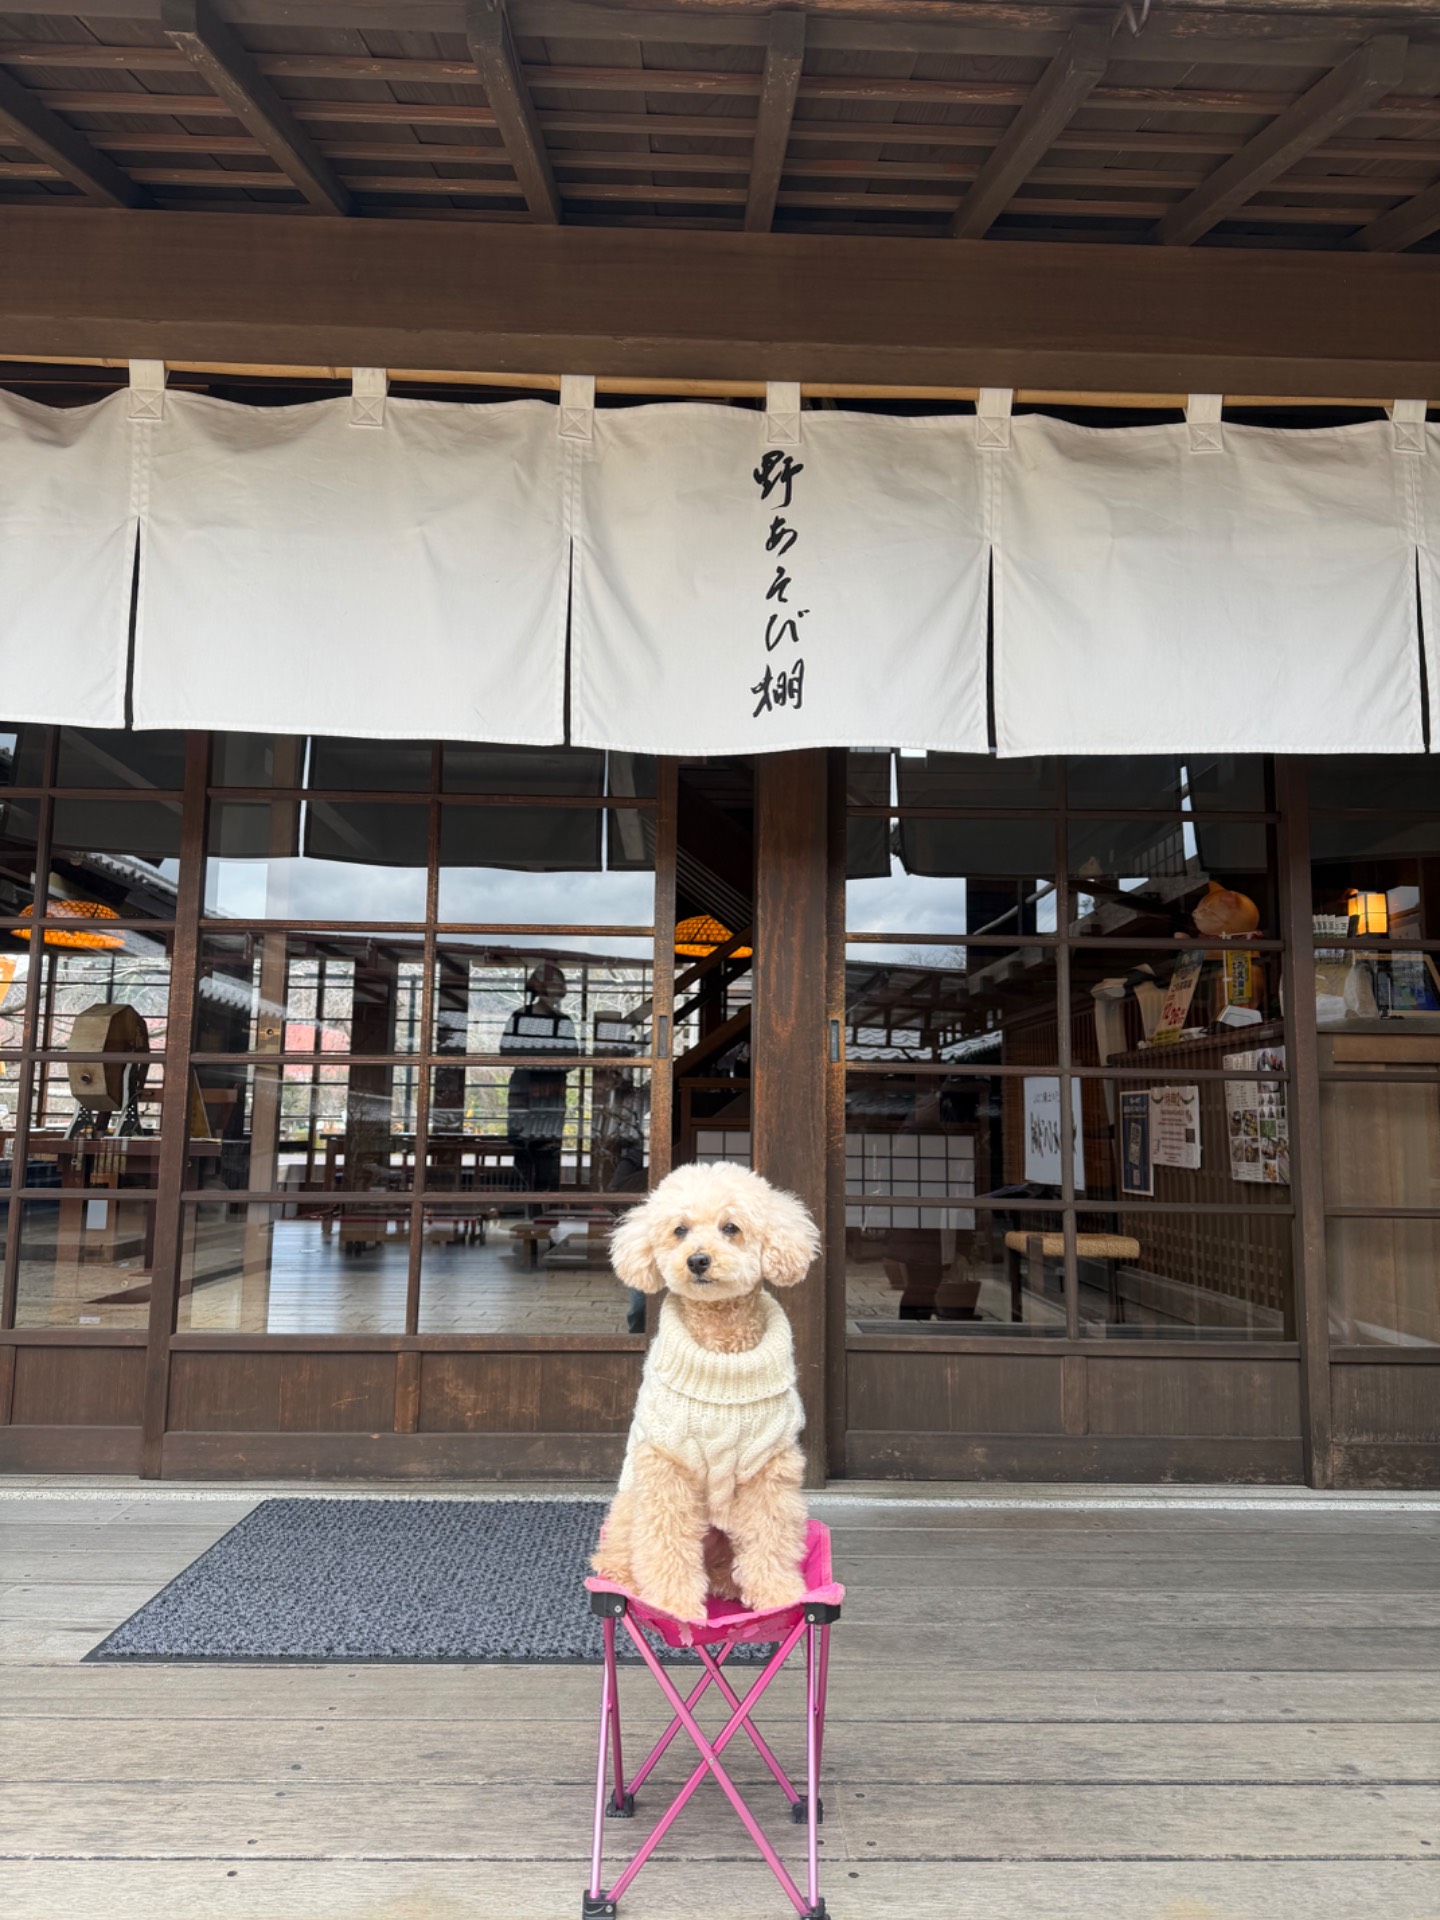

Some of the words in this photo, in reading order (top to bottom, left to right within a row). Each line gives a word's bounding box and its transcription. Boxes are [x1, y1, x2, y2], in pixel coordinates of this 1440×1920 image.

[750, 449, 810, 718] 野あそび棚
